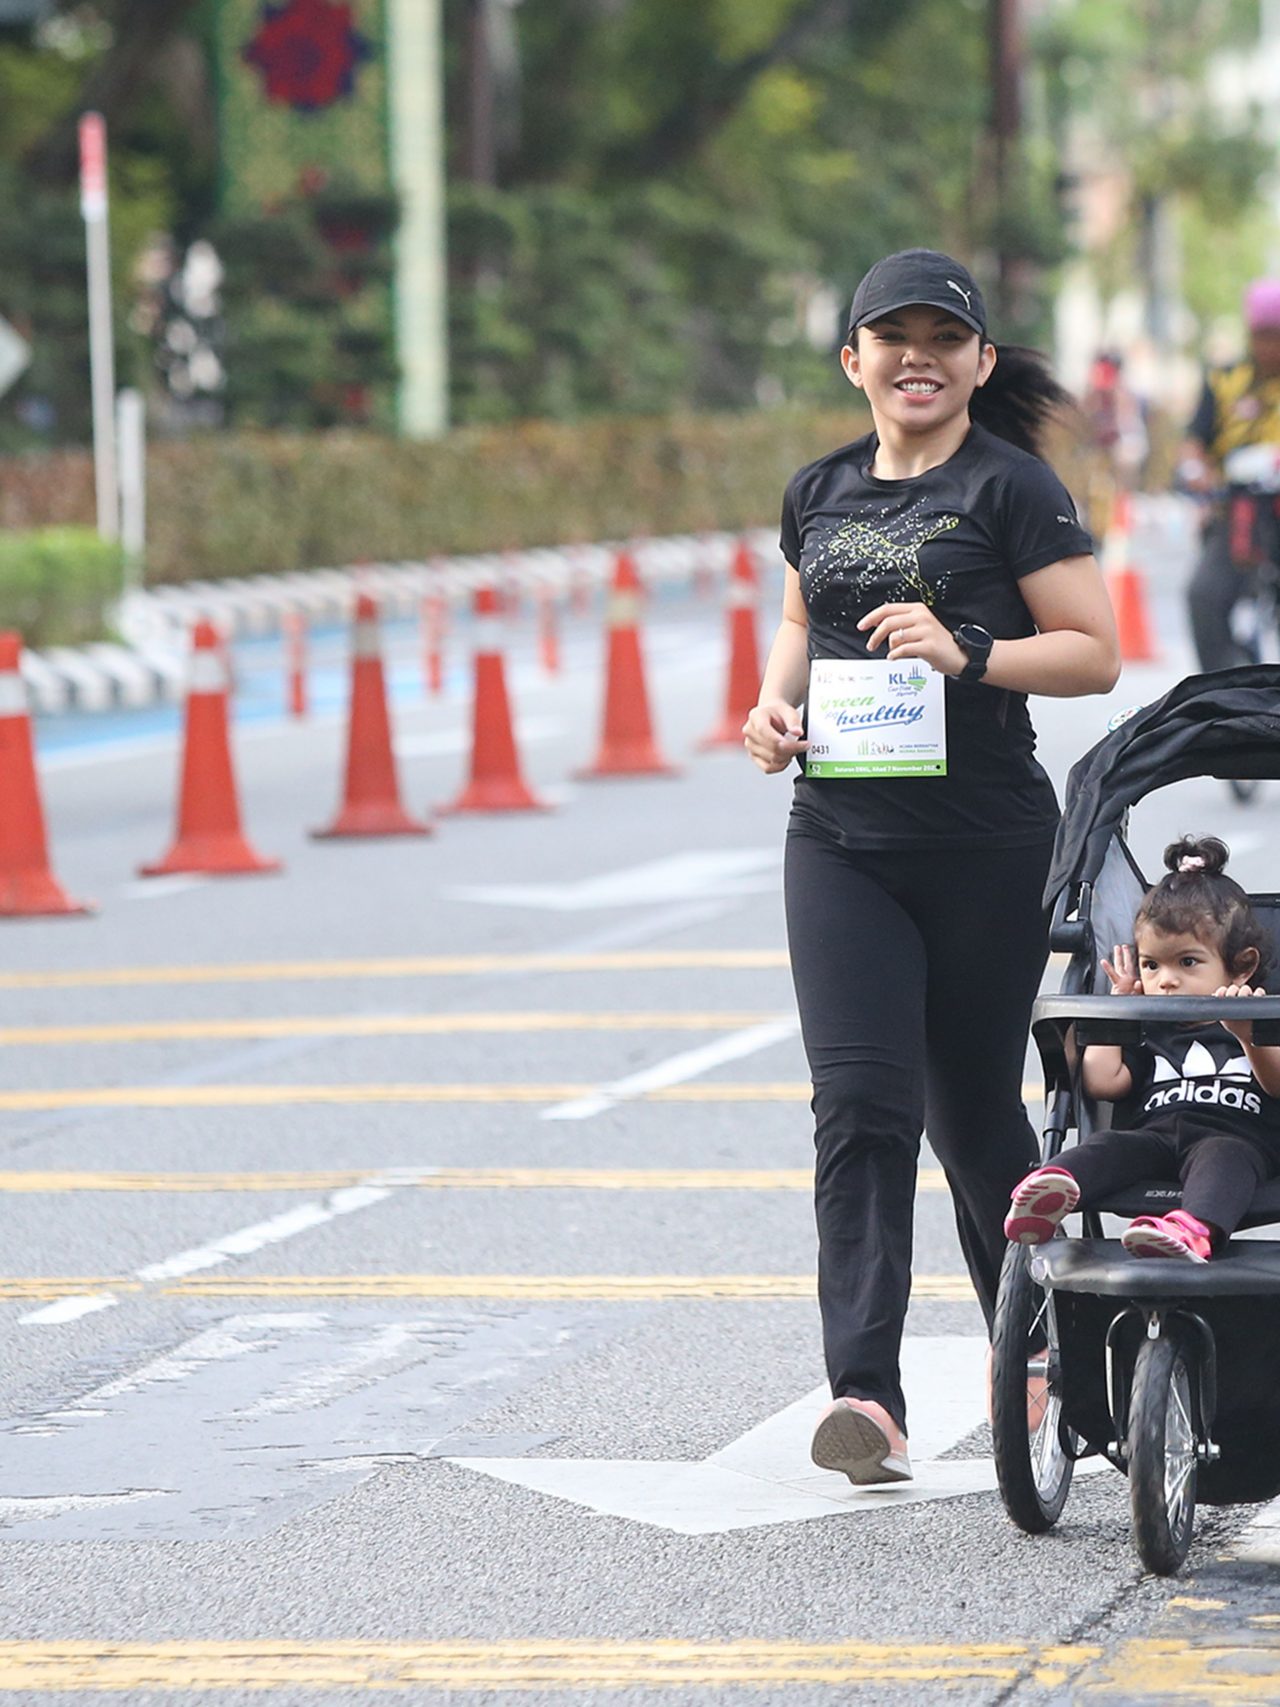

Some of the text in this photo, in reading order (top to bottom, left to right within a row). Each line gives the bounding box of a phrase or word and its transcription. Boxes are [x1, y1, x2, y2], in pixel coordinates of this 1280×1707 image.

[889, 673, 907, 685] KL
[836, 702, 925, 726] healthy
[811, 744, 830, 755] 0431
[1144, 1079, 1262, 1114] adidas
